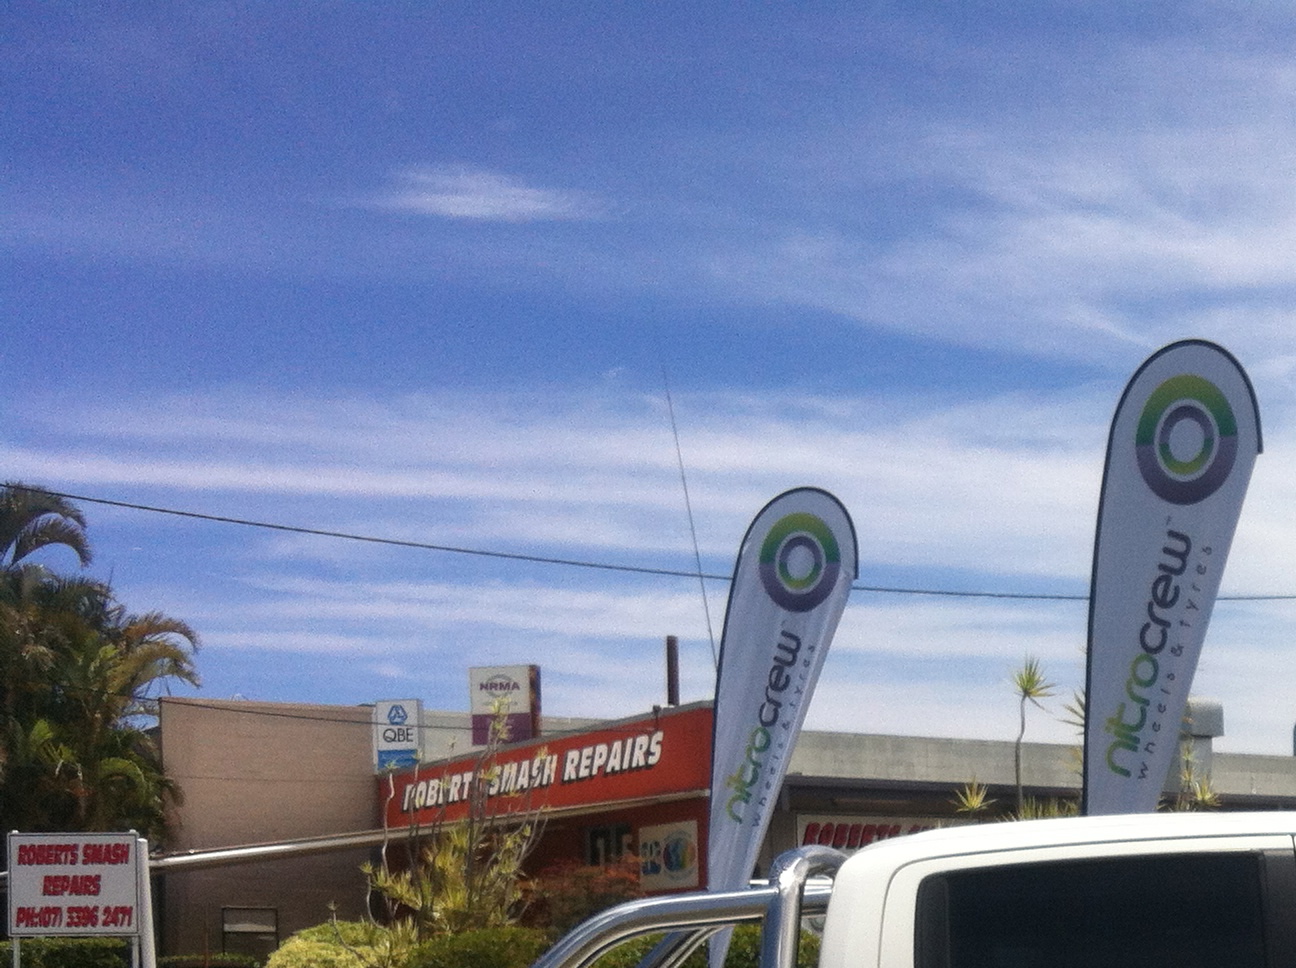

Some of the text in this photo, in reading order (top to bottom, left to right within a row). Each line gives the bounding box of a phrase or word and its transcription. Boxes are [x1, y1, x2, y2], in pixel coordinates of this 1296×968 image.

[1105, 529, 1192, 778] nitrocrew
[1138, 546, 1212, 780] wheels & tyres
[479, 681, 520, 691] NRMA
[383, 728, 414, 743] QBE
[725, 629, 802, 824] nitrocrew
[403, 730, 664, 811] ROBRT SMASH REPAIRS
[17, 843, 130, 866] ROBERTS SMASH
[42, 874, 101, 896] REPAIRS
[102, 905, 133, 927] 2471
